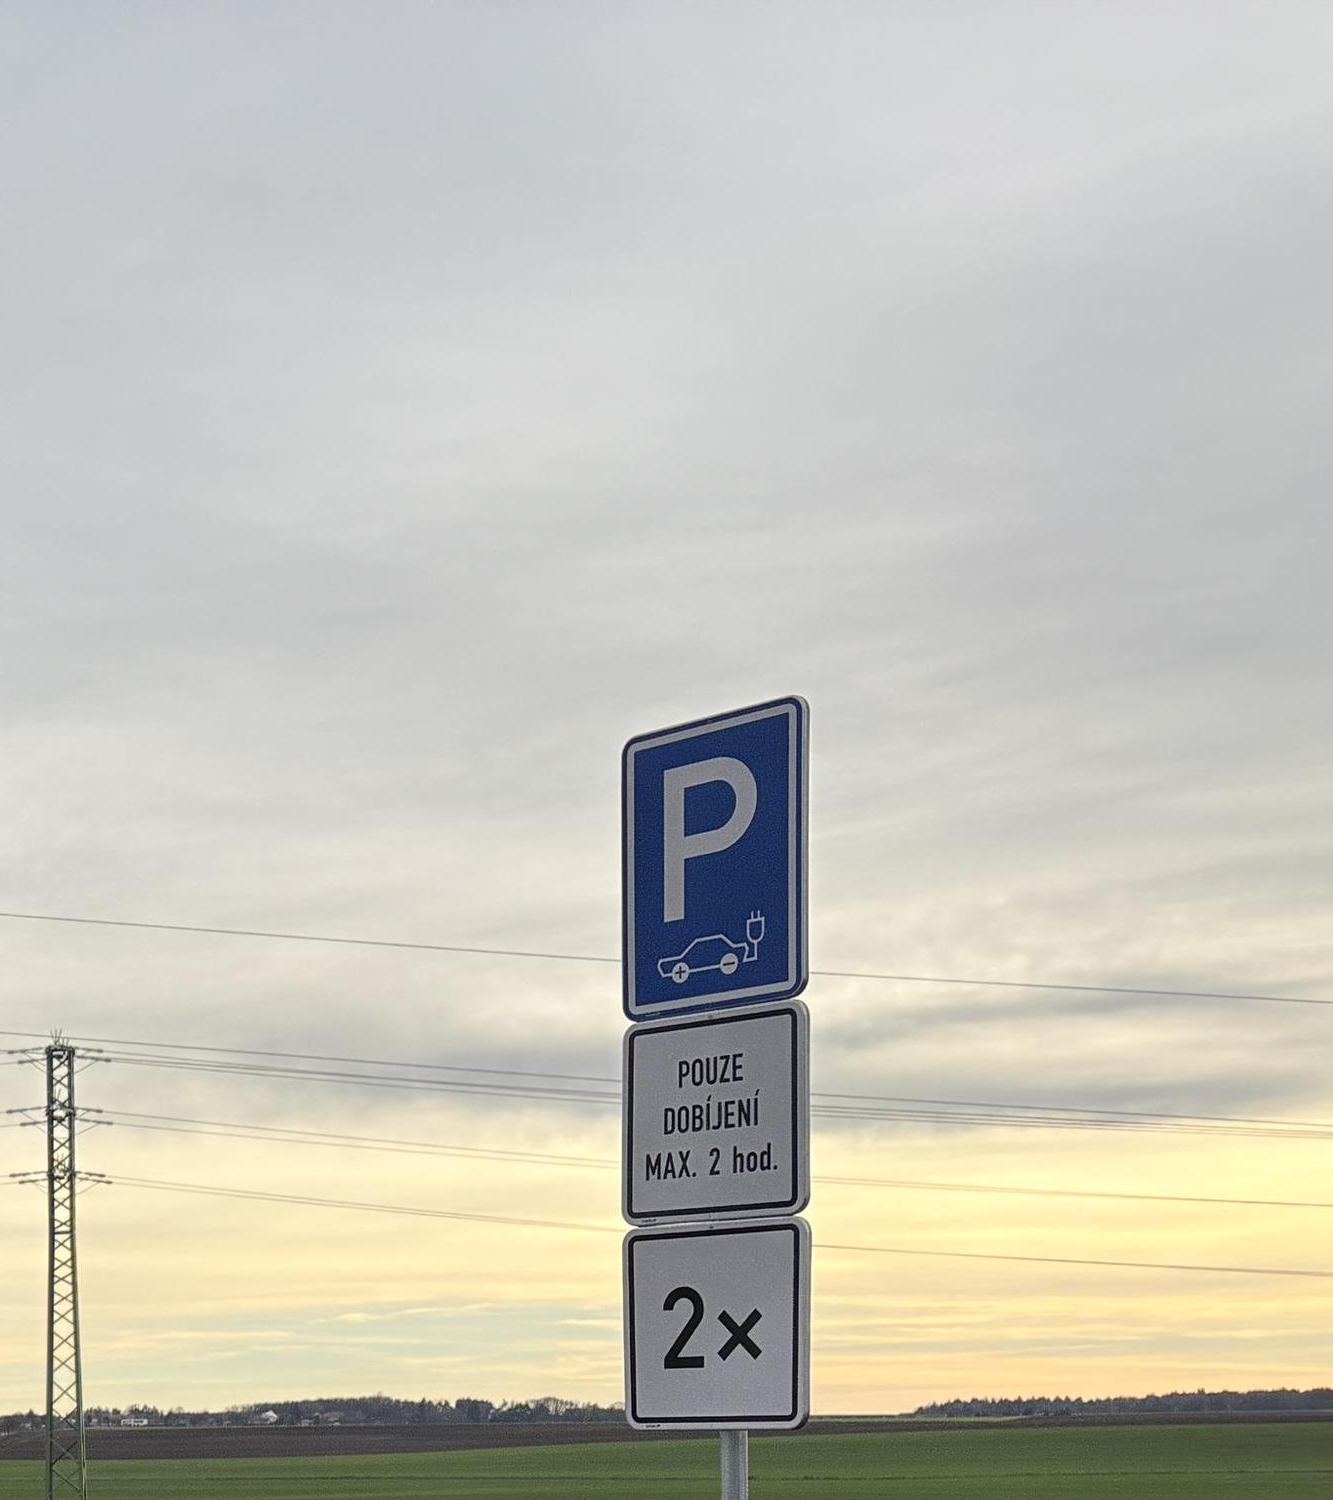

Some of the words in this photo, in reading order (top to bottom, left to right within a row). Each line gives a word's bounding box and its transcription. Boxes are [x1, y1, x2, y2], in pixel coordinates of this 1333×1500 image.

[664, 757, 758, 923] P
[678, 1053, 744, 1089] POUZE
[663, 1088, 760, 1135] DOBÍJENÍ
[645, 1150, 697, 1181] MAX.
[708, 1147, 721, 1176] 2
[733, 1142, 778, 1174] hod.
